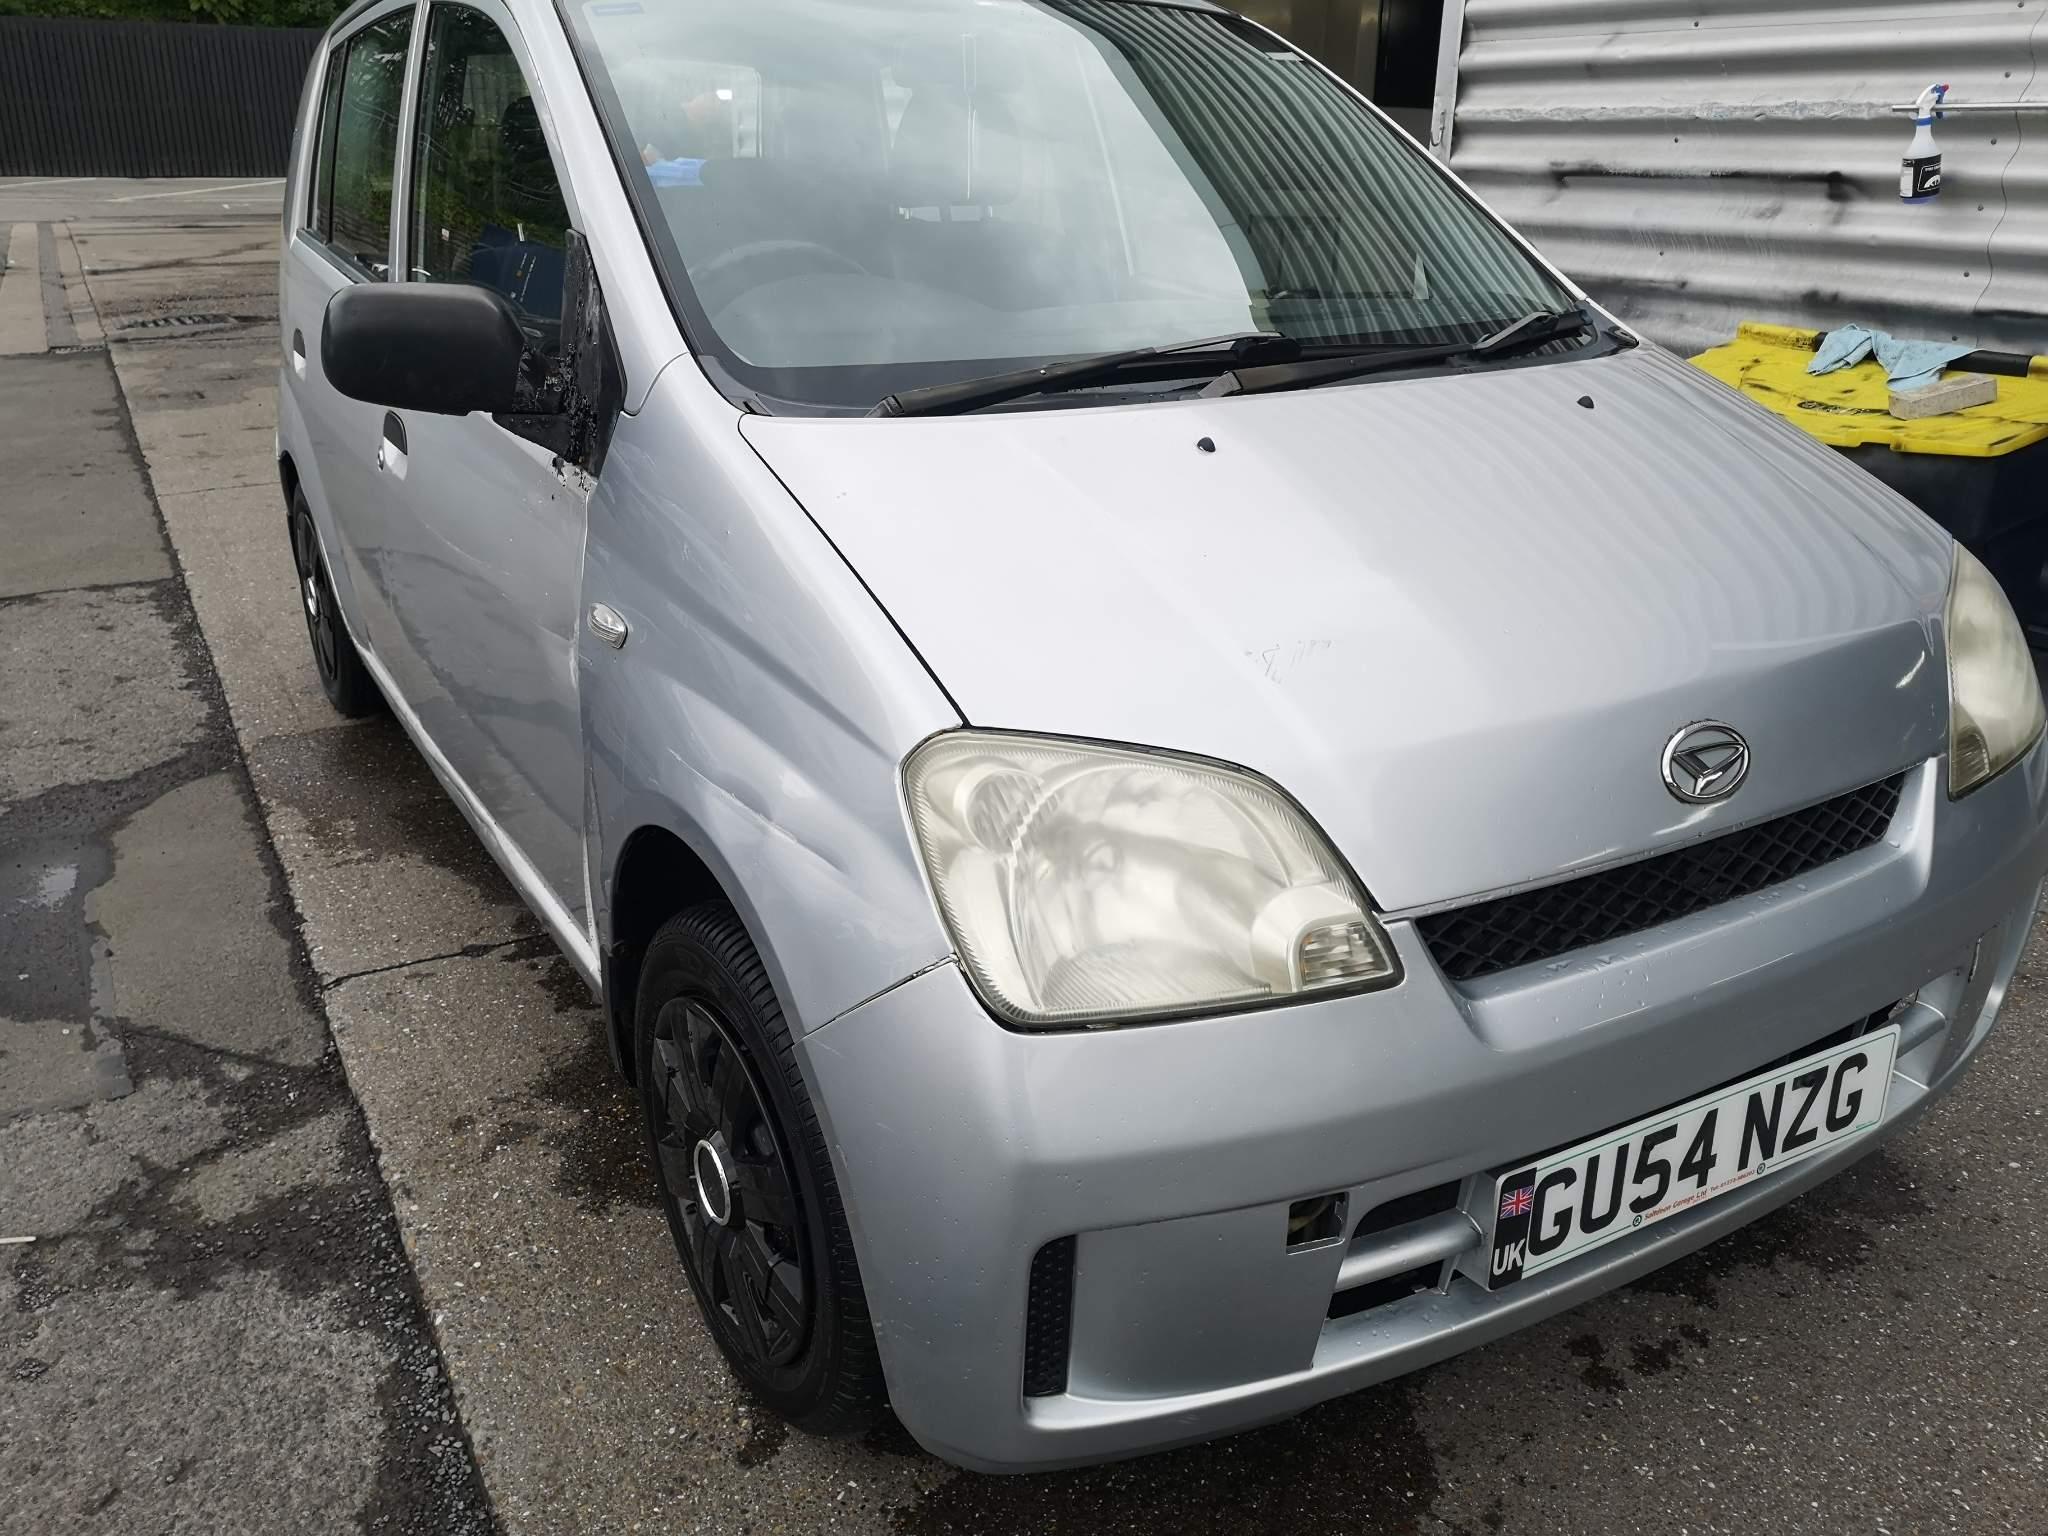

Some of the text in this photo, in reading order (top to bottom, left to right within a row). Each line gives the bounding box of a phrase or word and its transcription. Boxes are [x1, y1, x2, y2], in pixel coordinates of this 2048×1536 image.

[1527, 1052, 1868, 1257] GU54 NZG
[1492, 1238, 1526, 1277] UK
